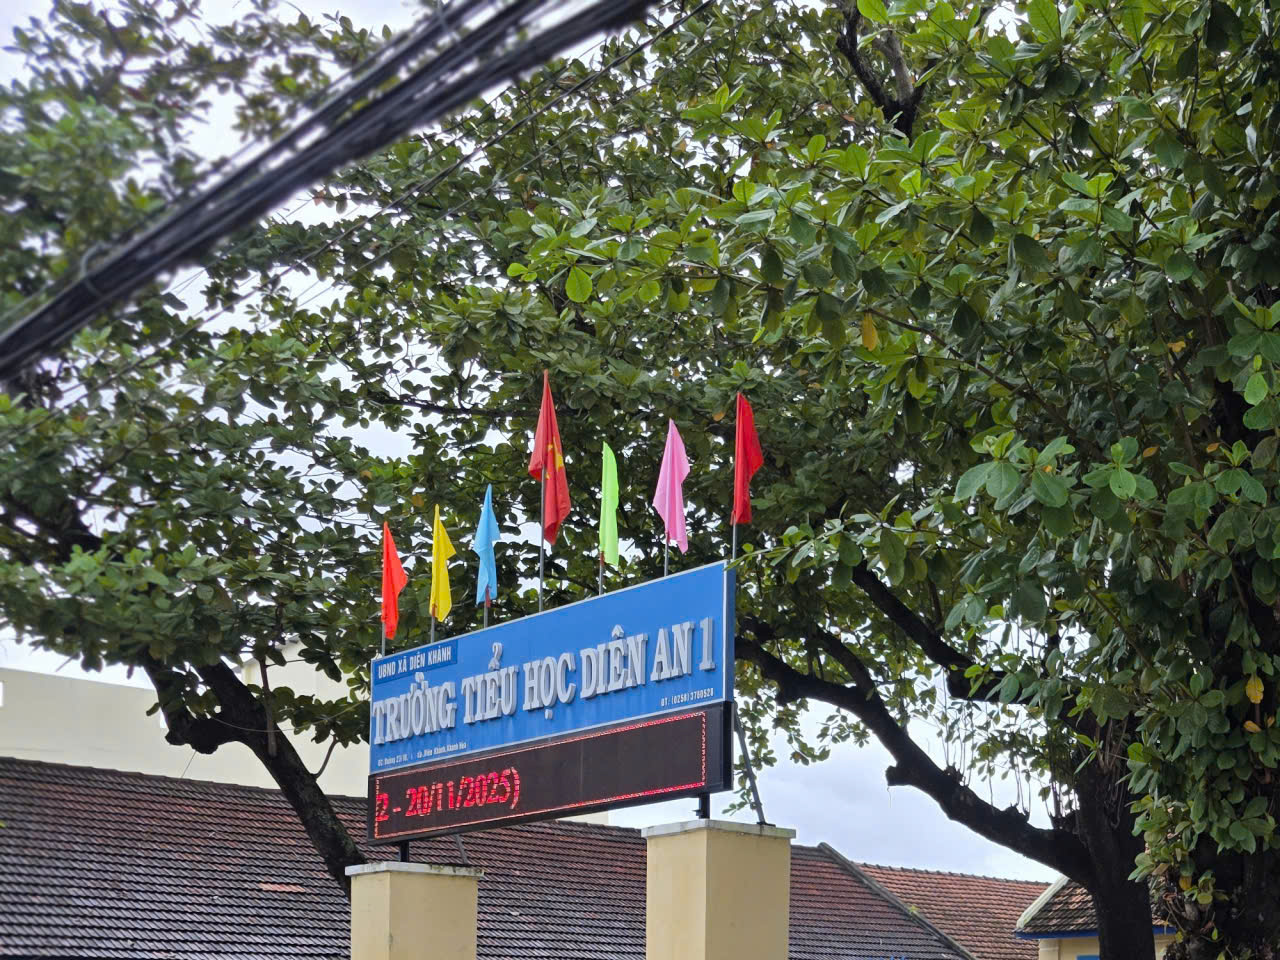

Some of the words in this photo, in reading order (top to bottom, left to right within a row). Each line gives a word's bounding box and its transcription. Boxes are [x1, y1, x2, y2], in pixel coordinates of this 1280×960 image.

[372, 671, 458, 745] TRƯỜNG
[461, 642, 519, 724] TIỂU
[522, 652, 577, 720] HỌC
[580, 624, 649, 699] DIÊN
[650, 621, 695, 681] AN
[700, 616, 716, 671] 1
[378, 661, 396, 679] UBND
[409, 651, 426, 670] DIÊN
[427, 645, 452, 666] KHÁNH
[405, 766, 521, 818] 20/11/2025)
